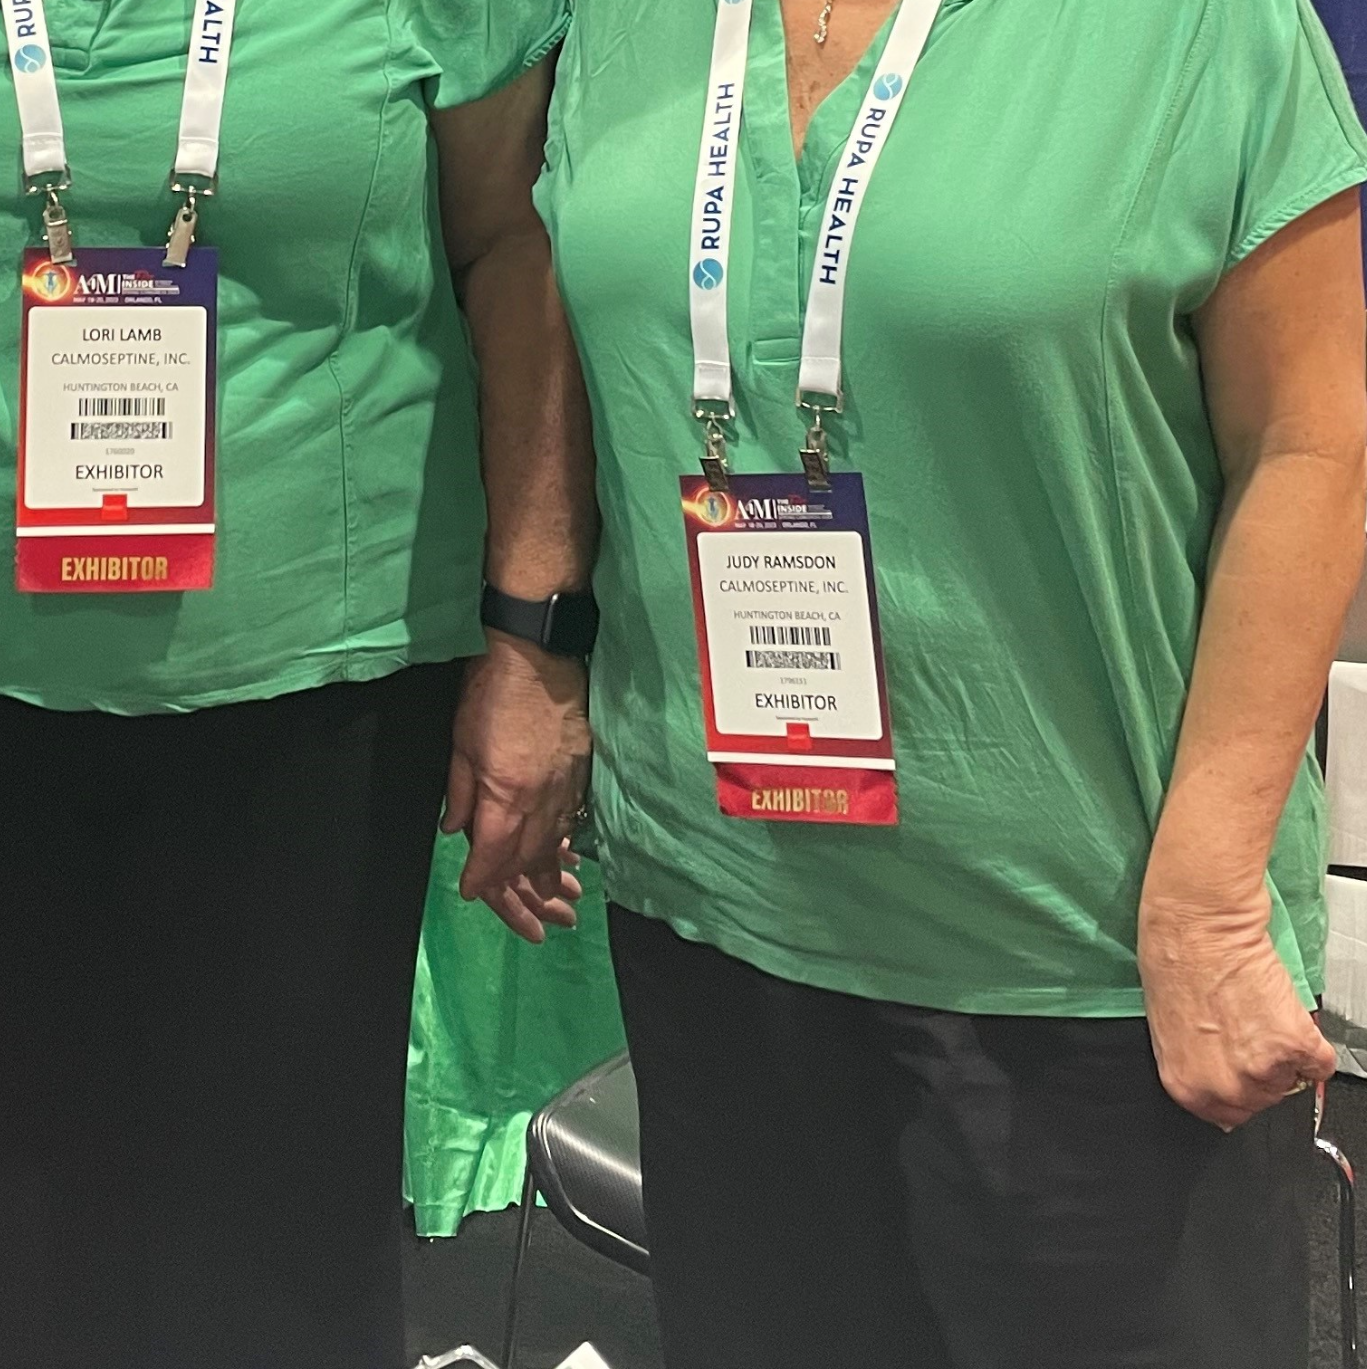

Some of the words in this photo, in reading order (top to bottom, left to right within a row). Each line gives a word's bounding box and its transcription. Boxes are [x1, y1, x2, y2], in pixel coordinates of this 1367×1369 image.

[708, 82, 735, 177] HEALTH
[846, 107, 887, 169] RUPA
[701, 185, 725, 250] RUPA
[819, 177, 859, 286] HEALTH
[82, 328, 115, 341] LORI
[119, 328, 162, 341] LAMB
[51, 352, 160, 366] CALMOSEPTINE,
[164, 352, 190, 365] INC.
[63, 382, 129, 392] HUNTINGTON
[130, 382, 164, 393] BEACH,
[165, 382, 179, 392] CA
[75, 464, 164, 480] EXHIBITOR
[61, 556, 168, 581] EXHIBITOR
[726, 555, 760, 569] JUDY
[764, 555, 836, 569] RAMSDON
[719, 579, 820, 595] CALMOSEPTINE,
[823, 580, 849, 594] INC.
[733, 609, 793, 620] HUNTINGTON
[795, 610, 826, 622] BEACH,
[828, 611, 842, 621] CA
[755, 693, 838, 711] EXHIBITOR
[751, 787, 849, 815] EXHIBITOR
